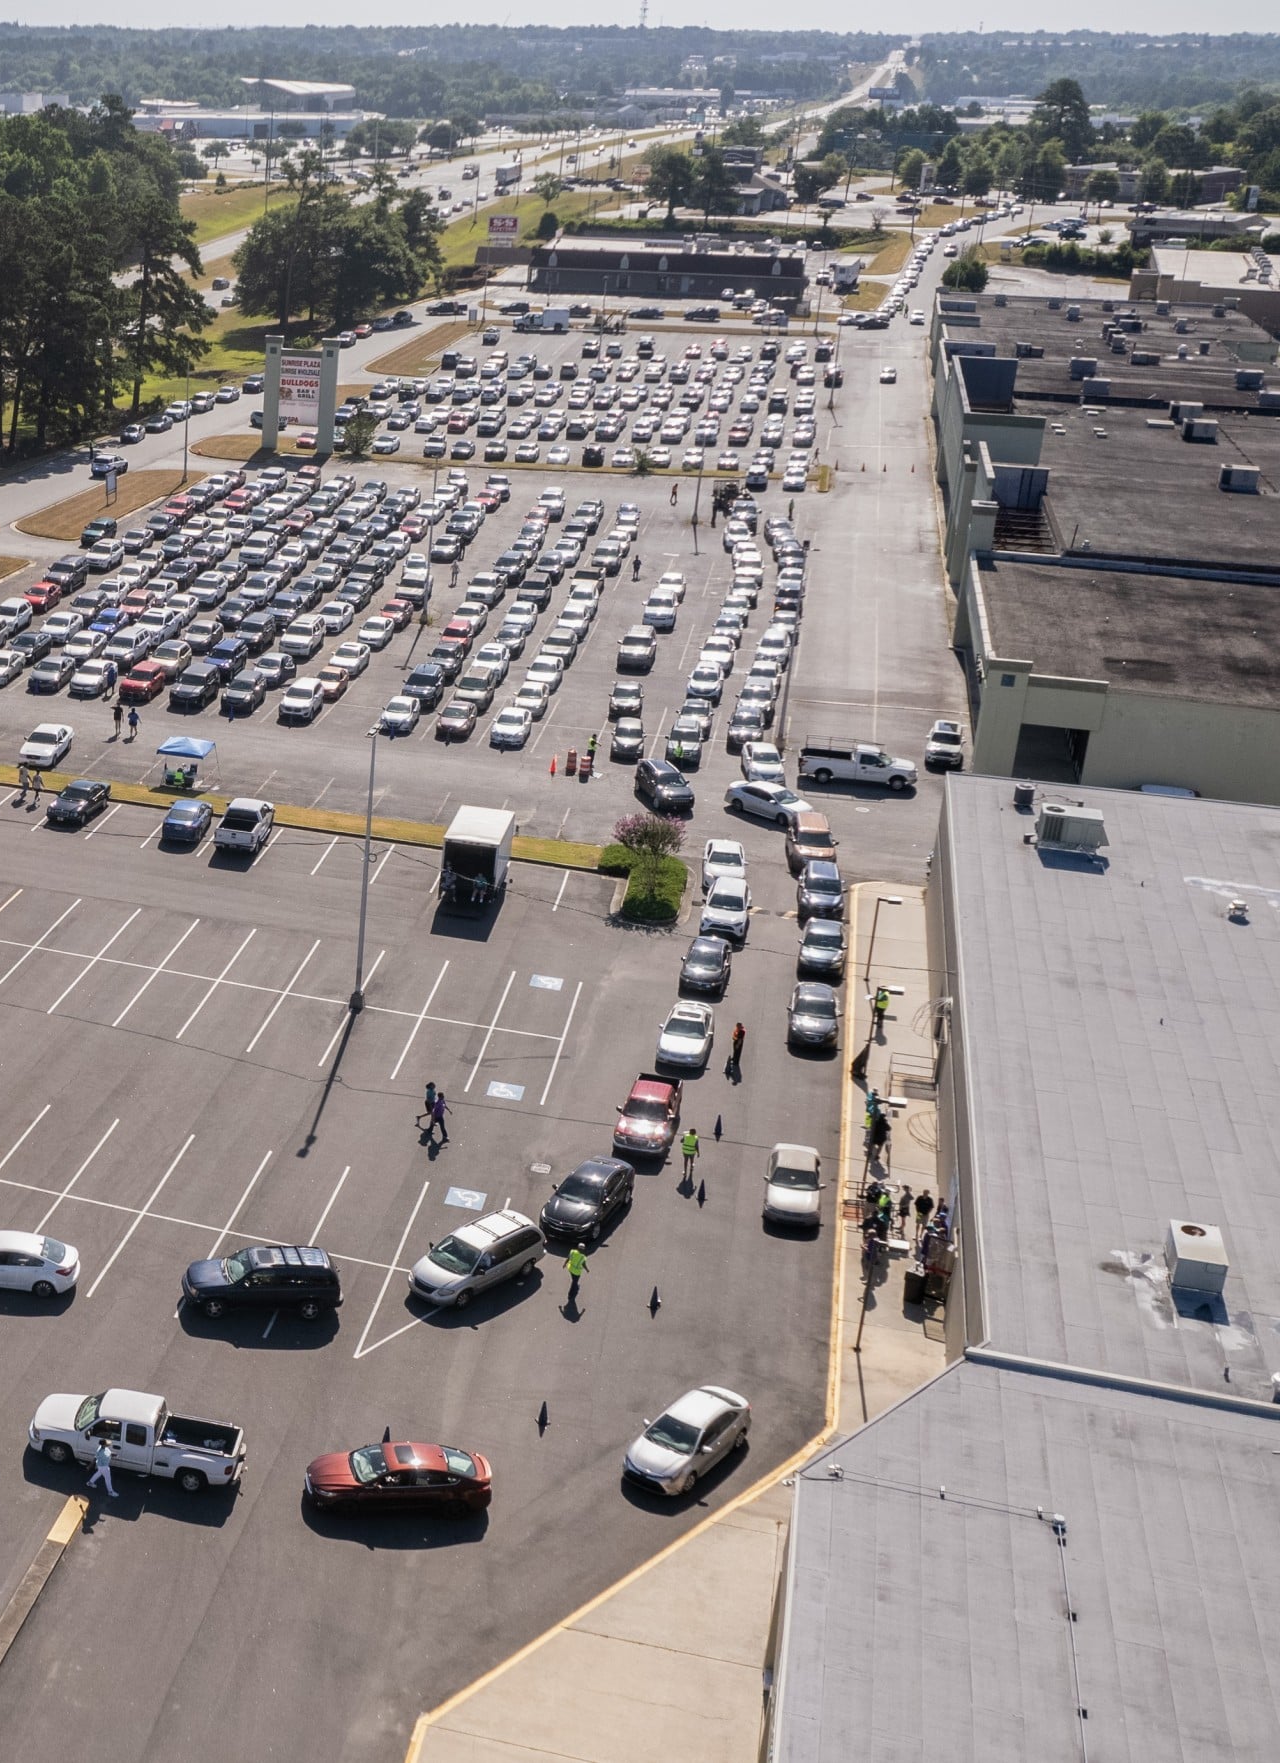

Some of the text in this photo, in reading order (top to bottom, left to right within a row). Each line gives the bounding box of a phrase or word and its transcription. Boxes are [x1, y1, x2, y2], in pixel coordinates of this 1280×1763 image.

[281, 359, 321, 368] SUNRISE PLAZA
[281, 379, 319, 388] BULLDOGS
